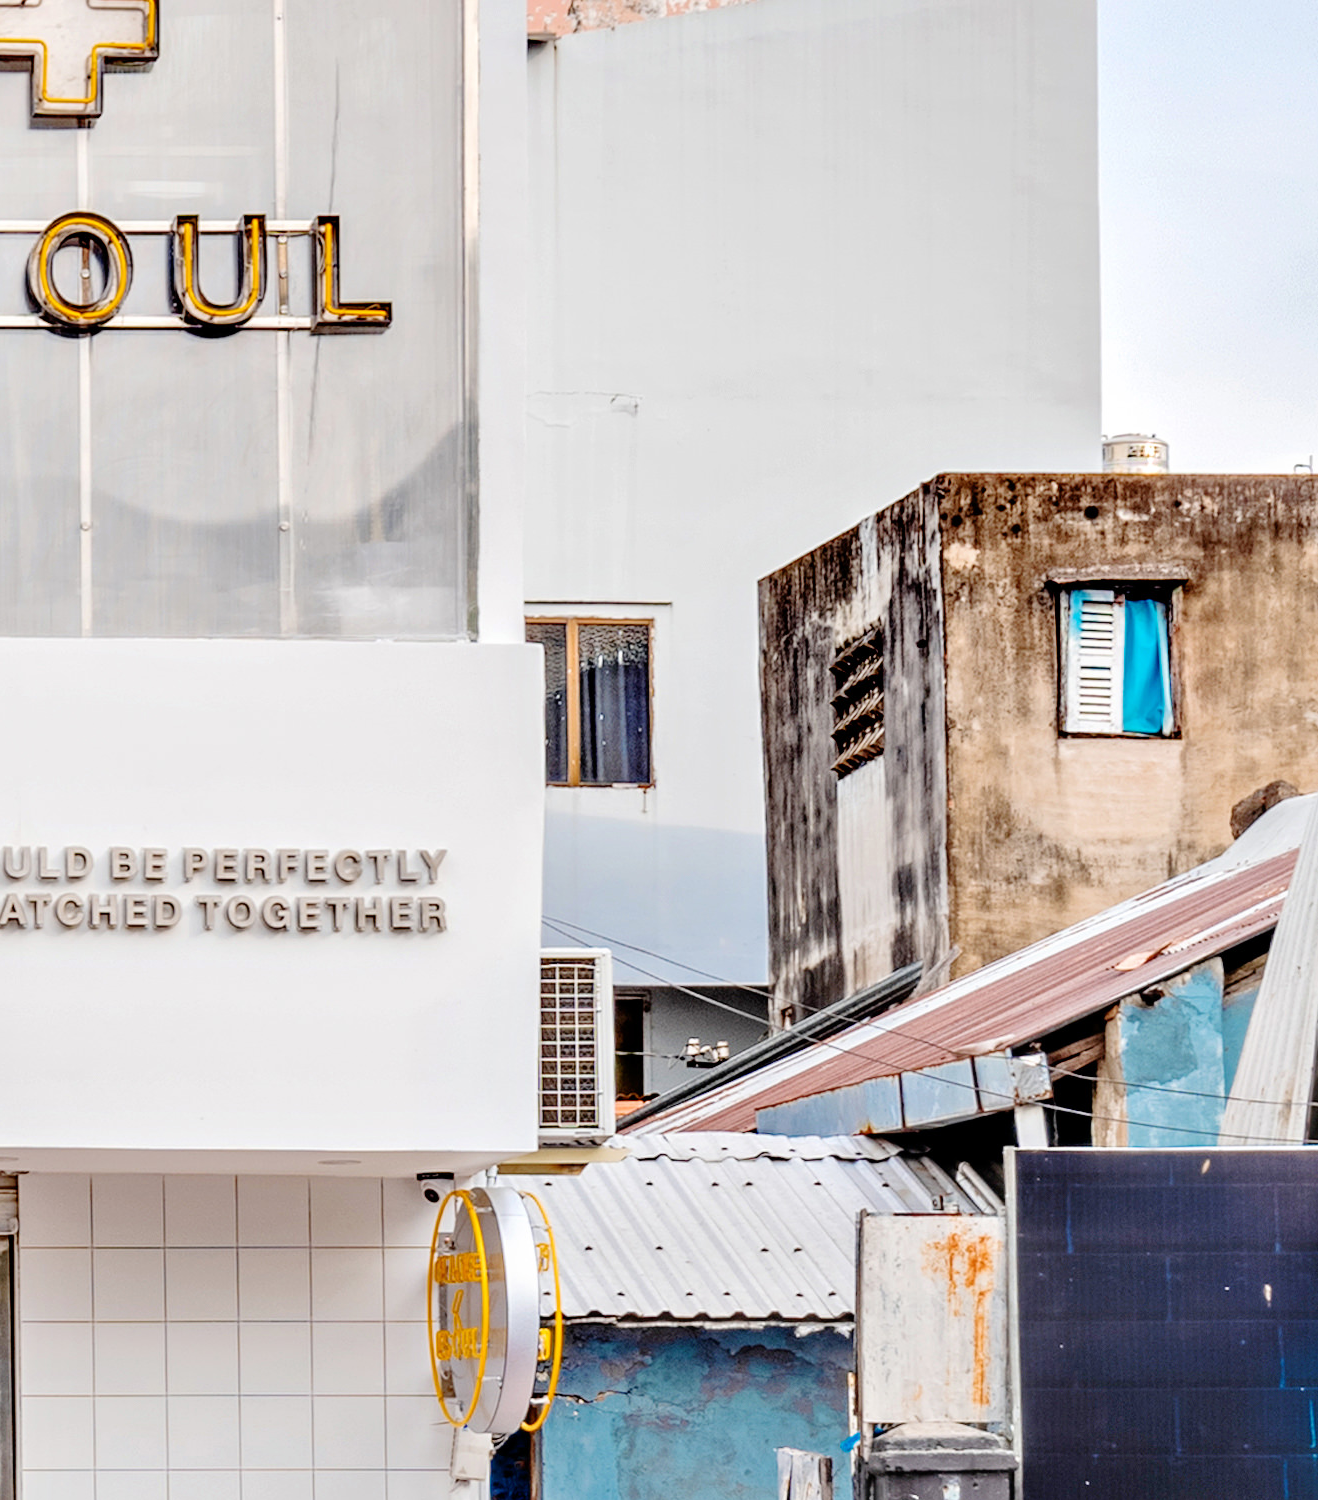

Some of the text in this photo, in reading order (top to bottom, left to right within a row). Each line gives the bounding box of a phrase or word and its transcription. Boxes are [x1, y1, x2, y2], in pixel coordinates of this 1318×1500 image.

[109, 846, 169, 882] BE
[181, 847, 449, 885] PERFECTLY
[195, 895, 449, 934] TOGETHER
